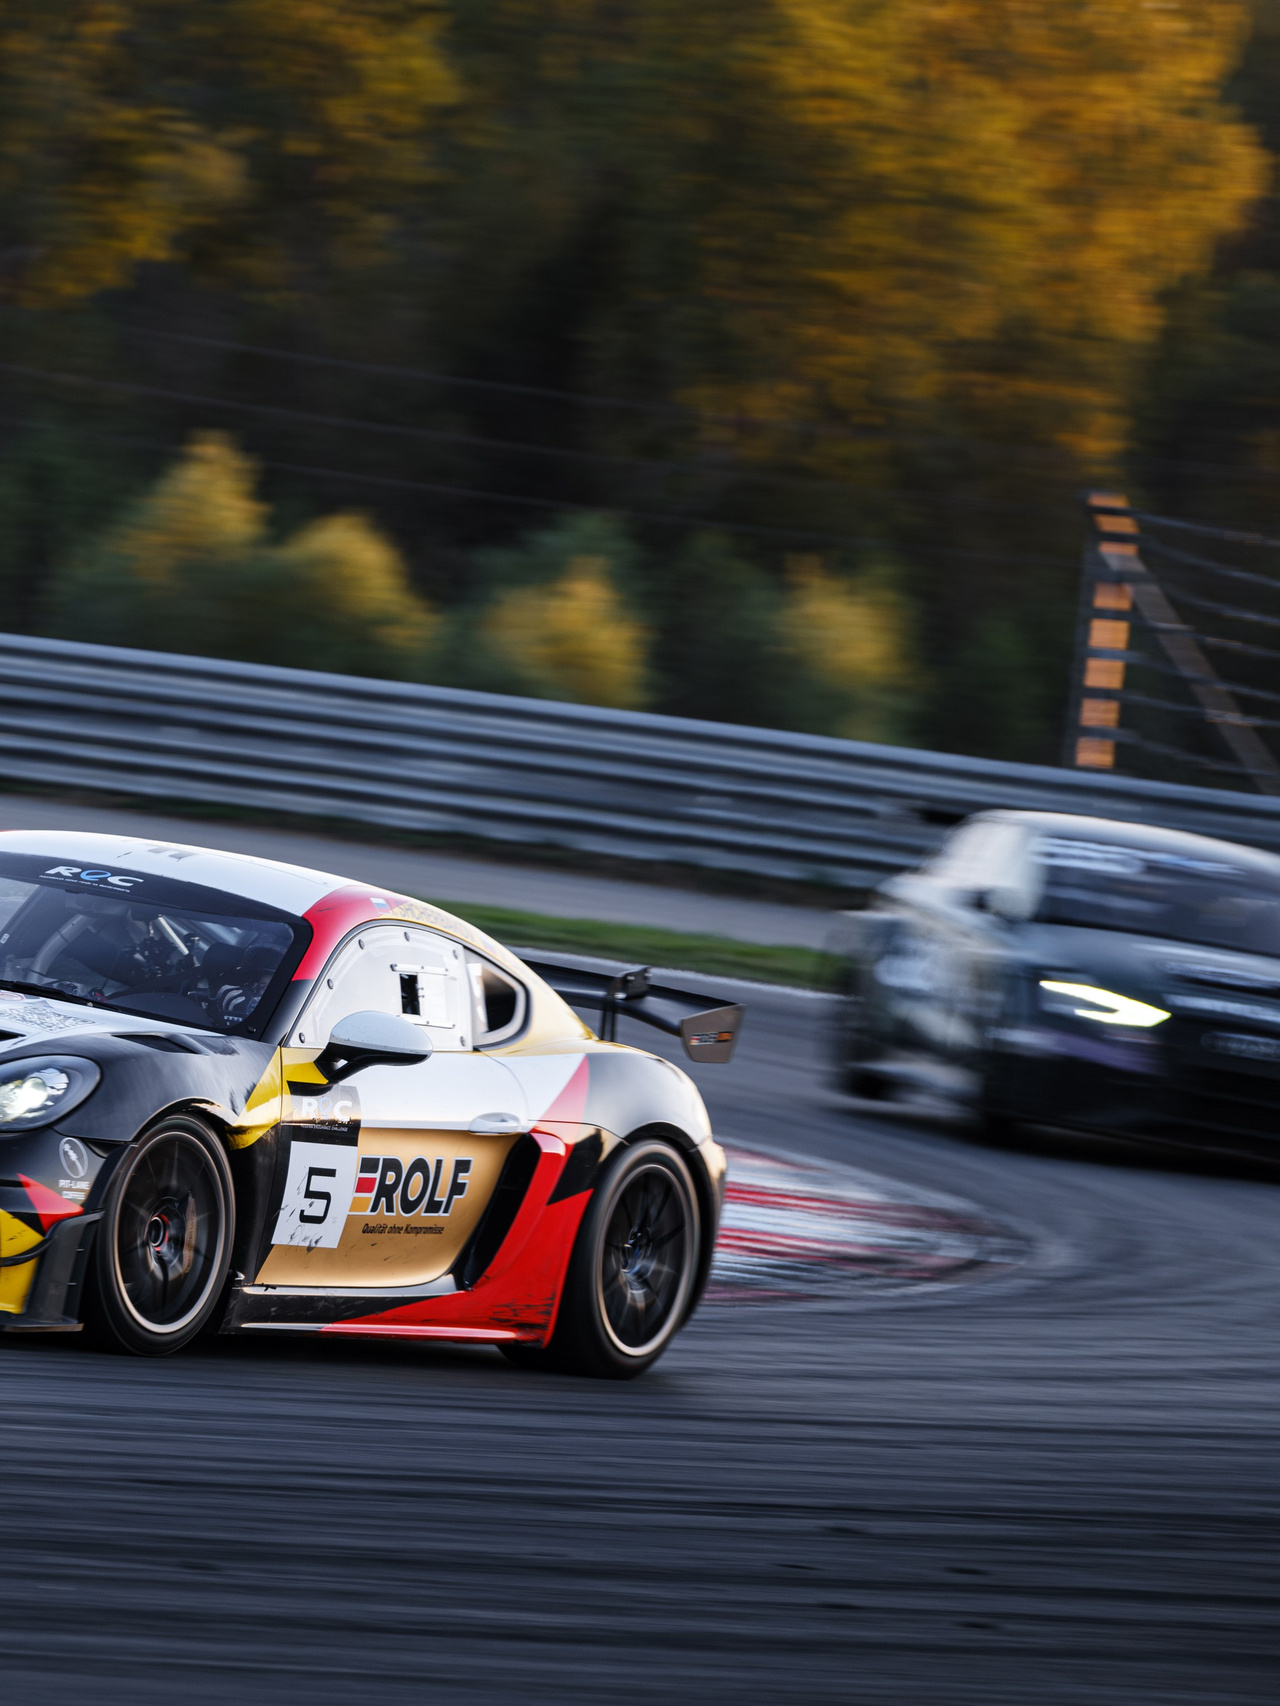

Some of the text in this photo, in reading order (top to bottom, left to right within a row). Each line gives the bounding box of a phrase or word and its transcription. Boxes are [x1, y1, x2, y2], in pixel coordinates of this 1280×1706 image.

[299, 1166, 337, 1225] 5
[370, 1155, 474, 1217] ROLF
[362, 1222, 445, 1237] Qualität ohne Kompromisse
